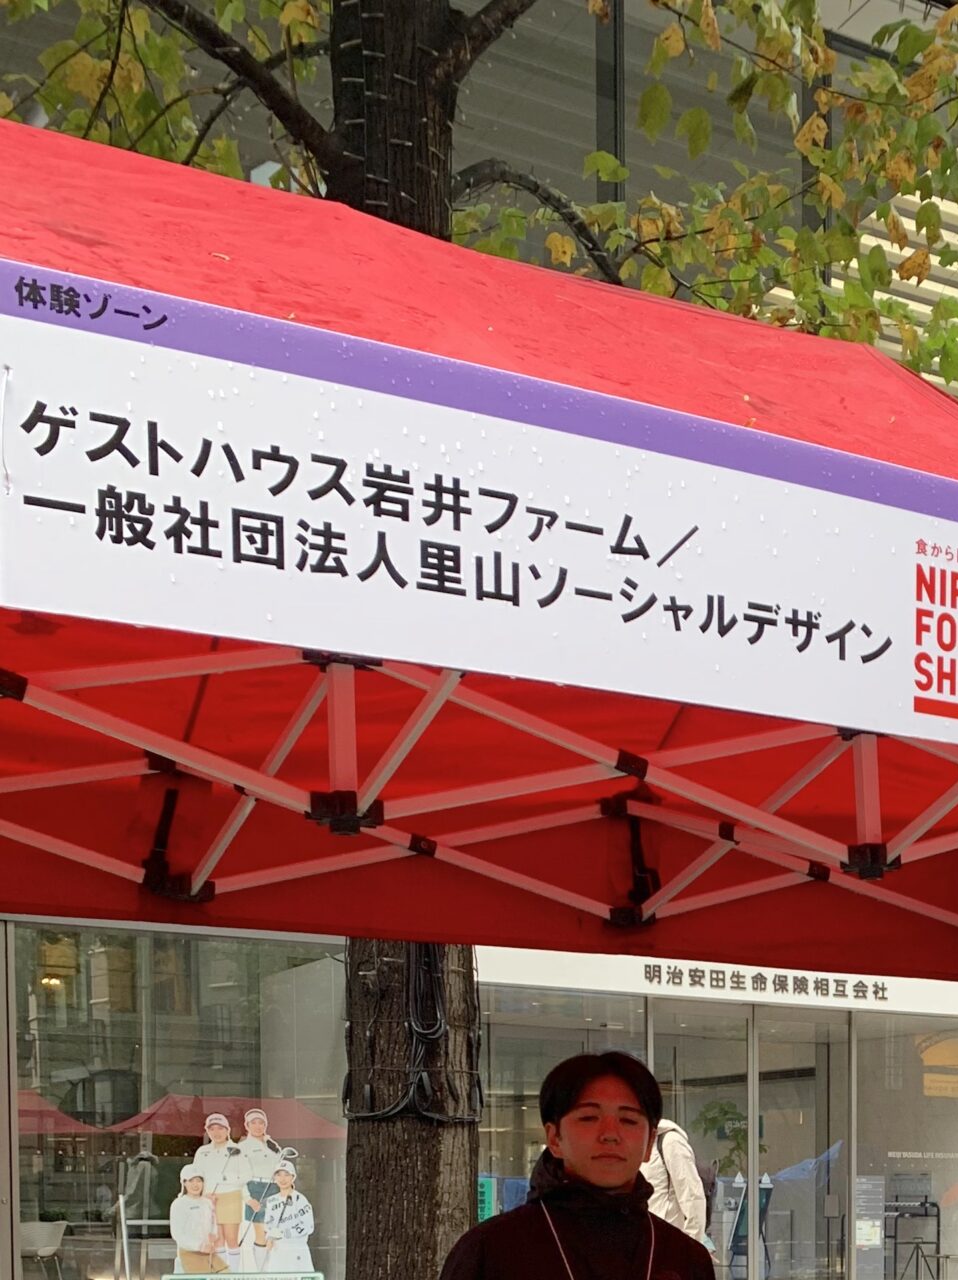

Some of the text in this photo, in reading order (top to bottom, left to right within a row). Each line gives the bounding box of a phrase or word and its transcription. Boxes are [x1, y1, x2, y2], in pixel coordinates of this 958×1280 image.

[13, 276, 168, 331] 体験ゾーン
[22, 484, 893, 664] 一般社団法人里山ソーシャルデザイン
[644, 963, 889, 1001] 明治安田生命保険相互会社
